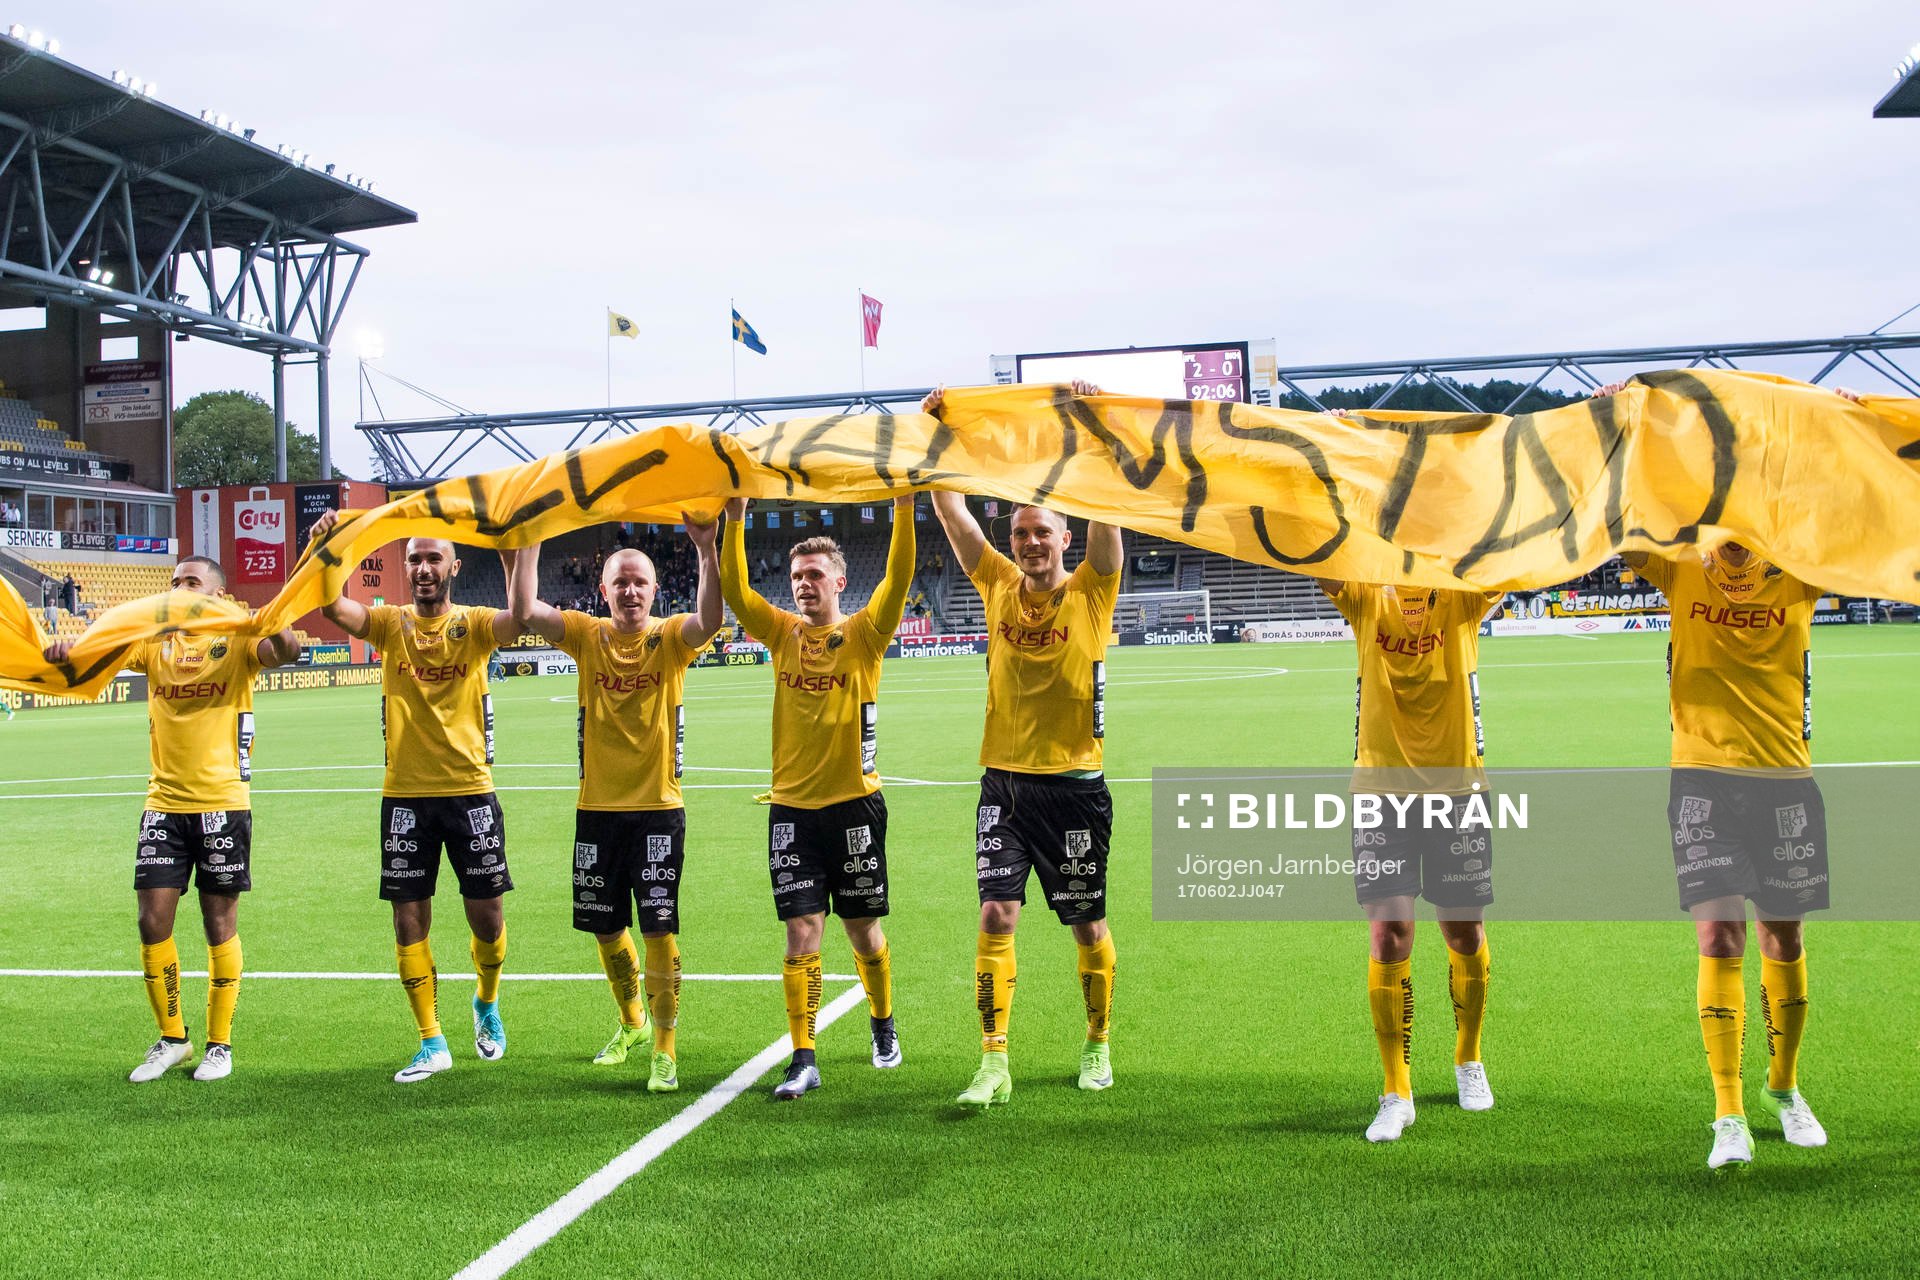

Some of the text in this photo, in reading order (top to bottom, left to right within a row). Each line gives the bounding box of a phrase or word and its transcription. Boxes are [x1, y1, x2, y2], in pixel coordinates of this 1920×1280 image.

[1193, 362, 1203, 378] 2
[1222, 361, 1232, 376] 0
[1191, 383, 1236, 400] 92:06
[13, 457, 25, 467] ON
[27, 459, 41, 468] ALL
[43, 460, 69, 471] LEVELS
[303, 493, 331, 501] SPABAD
[238, 508, 281, 531] City
[7, 529, 54, 547] SERNEKE
[86, 534, 106, 546] BYGG
[244, 556, 276, 571] 7-23
[361, 557, 383, 571] BORÅS
[362, 574, 381, 587] STAD
[1511, 595, 1546, 620] 40
[1689, 601, 1786, 629] PULSEN
[997, 620, 1069, 647] PULSEN
[1261, 630, 1344, 639] BORÅS DJURPARK
[900, 643, 978, 658] brainforest.
[1375, 629, 1445, 657] PULSEN
[311, 648, 350, 664] Assemblin
[728, 654, 755, 665] EAB
[270, 673, 281, 690] IF
[282, 670, 330, 689] ELFSBORG
[335, 668, 384, 686] HAMMARBY
[594, 671, 661, 693] PULSEN
[778, 671, 847, 691] PULSEN
[116, 681, 131, 702] IF
[203, 835, 234, 850] ellos
[1674, 822, 1716, 845] ellos
[384, 835, 418, 852] ellos
[470, 834, 501, 852] ellos
[1450, 835, 1486, 855] ellos
[1772, 841, 1816, 861] ellos
[770, 851, 801, 870] ellos
[843, 856, 878, 874] ellos
[1059, 858, 1097, 876] ellos
[573, 869, 605, 888] ellos
[641, 863, 676, 881] ellos
[977, 867, 1013, 879] GRINDEN
[1051, 888, 1103, 901] JÄRNGRINDEN
[806, 966, 822, 1041] SPRINGYARD
